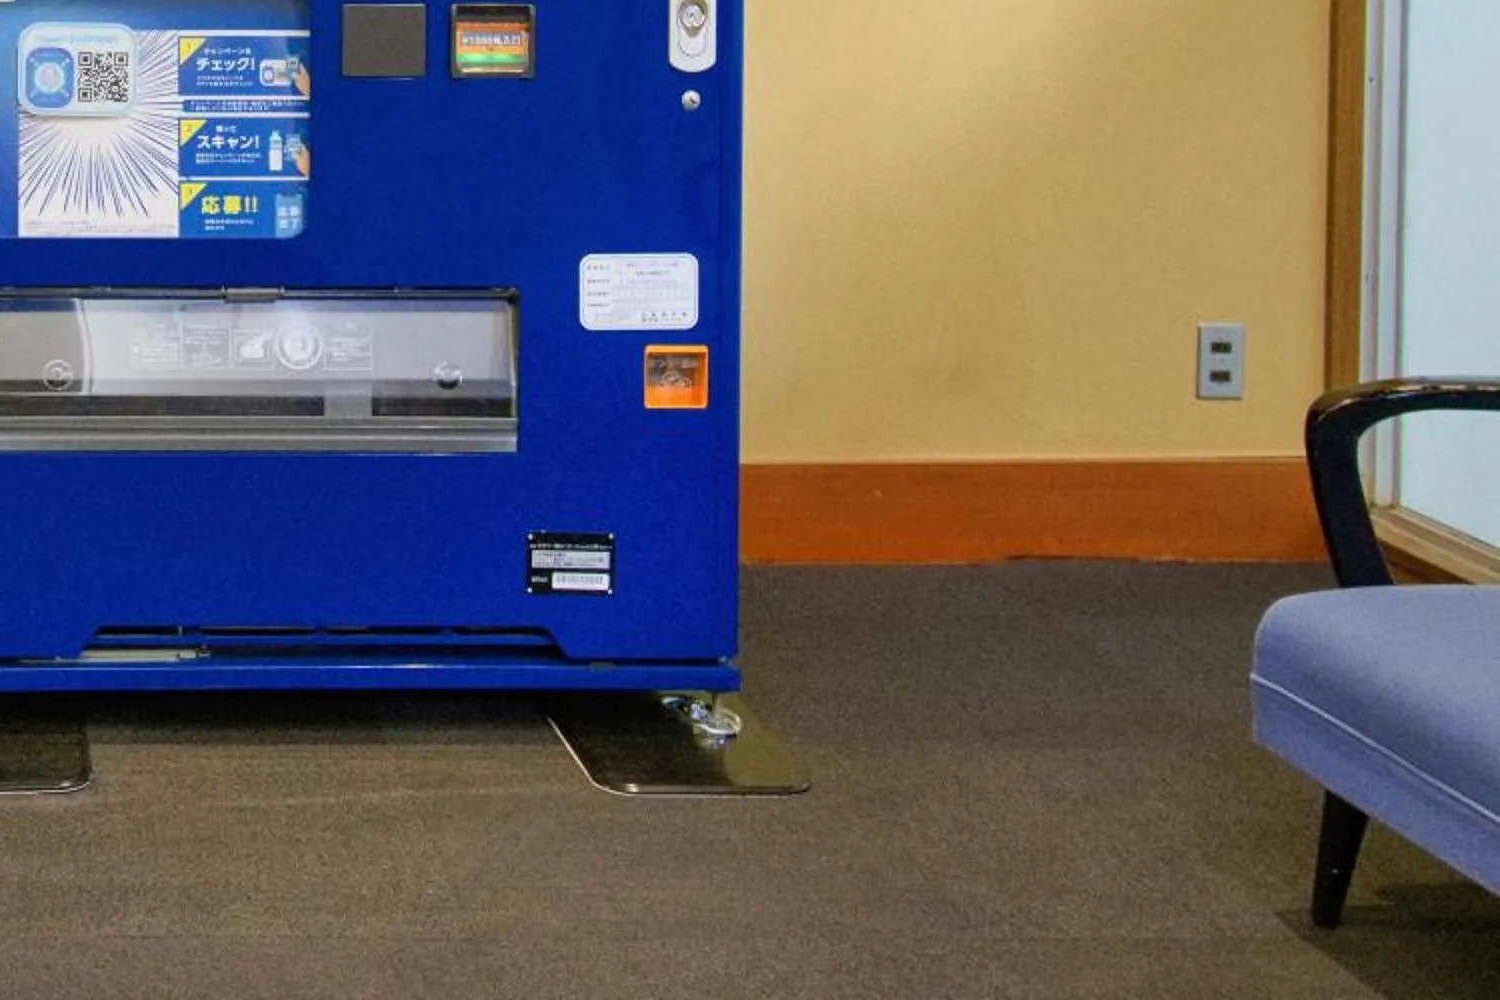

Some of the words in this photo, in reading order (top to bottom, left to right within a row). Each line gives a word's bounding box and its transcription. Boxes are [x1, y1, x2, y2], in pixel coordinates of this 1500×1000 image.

[196, 57, 255, 72] チェック!
[197, 135, 260, 149] スキャン!
[202, 196, 258, 214] 応募!!
